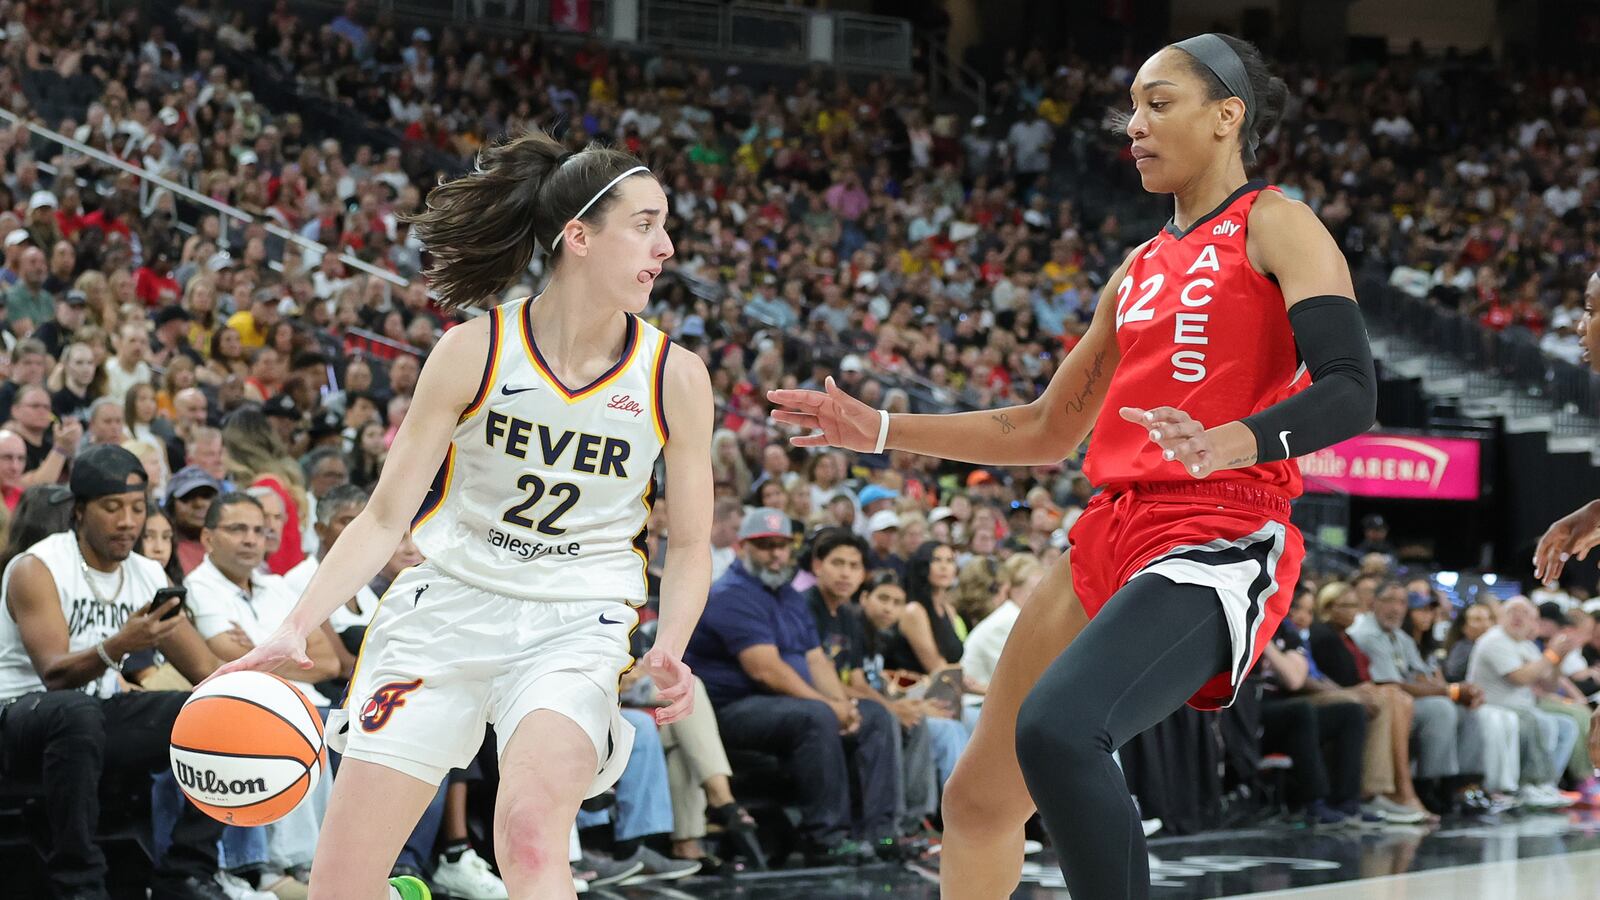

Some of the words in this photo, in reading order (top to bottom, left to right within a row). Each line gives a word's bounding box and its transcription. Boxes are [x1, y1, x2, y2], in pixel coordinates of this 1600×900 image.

[1212, 219, 1241, 237] ally
[1116, 273, 1165, 333] 22
[1171, 244, 1220, 383] ACES
[606, 394, 644, 417] Lilly
[485, 409, 631, 479] FEVER
[1349, 456, 1431, 482] ARENA
[502, 473, 581, 536] 22
[487, 528, 580, 561] salesfce
[110, 602, 135, 631] RO
[175, 758, 268, 795] Wilson
